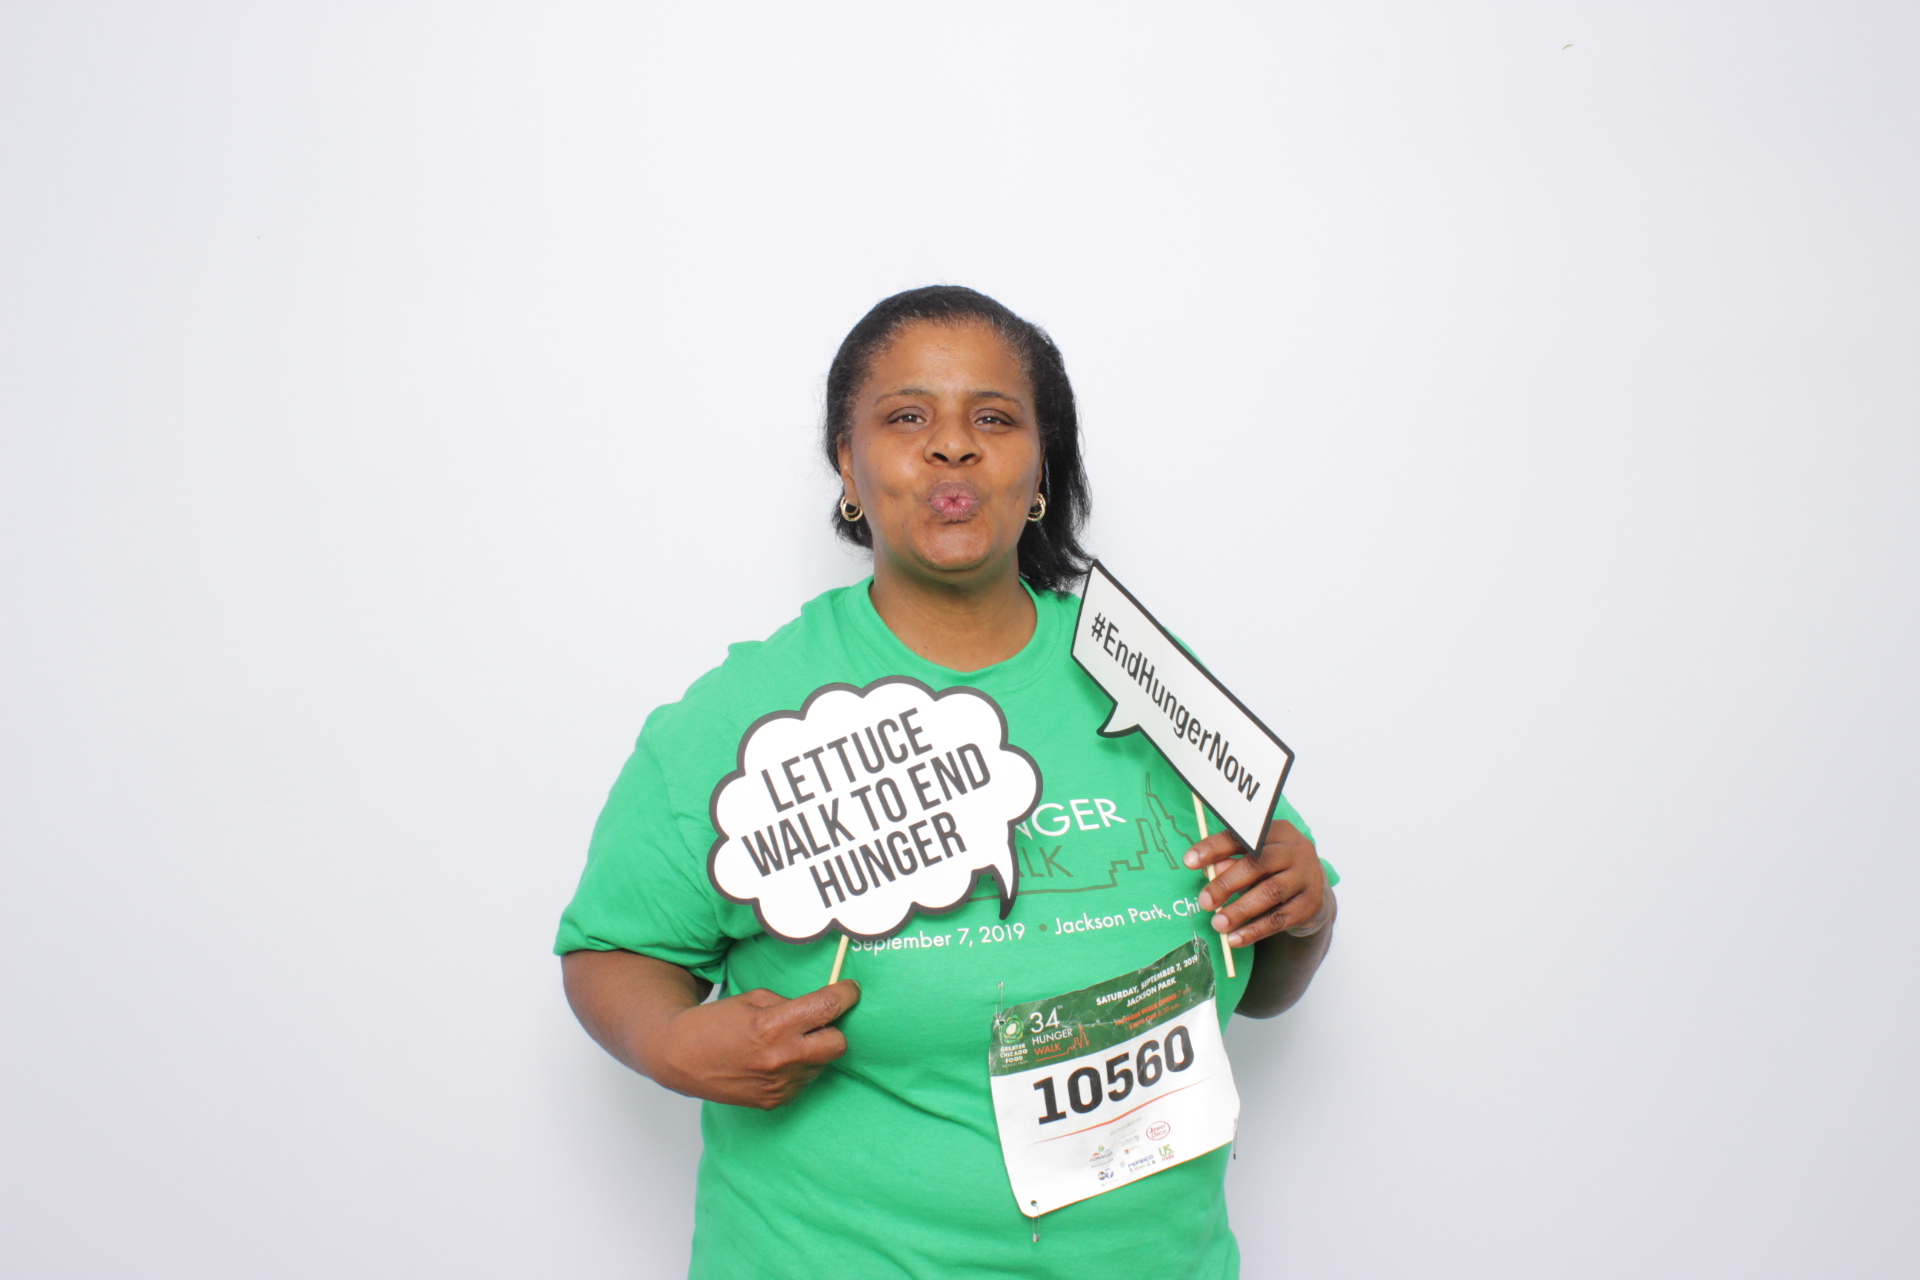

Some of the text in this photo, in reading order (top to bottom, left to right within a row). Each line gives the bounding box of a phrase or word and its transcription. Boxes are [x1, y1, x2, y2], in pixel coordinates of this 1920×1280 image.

[1091, 612, 1260, 802] #EndHungerNow
[761, 707, 933, 813] LETTUCE
[741, 743, 991, 877] WALK TO END
[809, 811, 967, 908] HUNGER
[1019, 845, 1074, 877] LK
[851, 931, 952, 956] September
[957, 928, 973, 947] 7,
[979, 923, 1026, 943] 2019
[1055, 913, 1126, 935] Jackson
[1128, 904, 1171, 923] Park,
[1096, 955, 1198, 1006] SATURDAY, SEPTEMBER 7, 2019
[1126, 977, 1177, 1007] JACKSON PARK
[1000, 1049, 1028, 1058] CHICAGO
[1032, 1028, 1073, 1046] HUNGER
[1034, 1043, 1062, 1055] WALK
[1005, 1056, 1023, 1064] FOOD
[1033, 1025, 1194, 1125] 10560
[1150, 1123, 1165, 1133] Jewel
